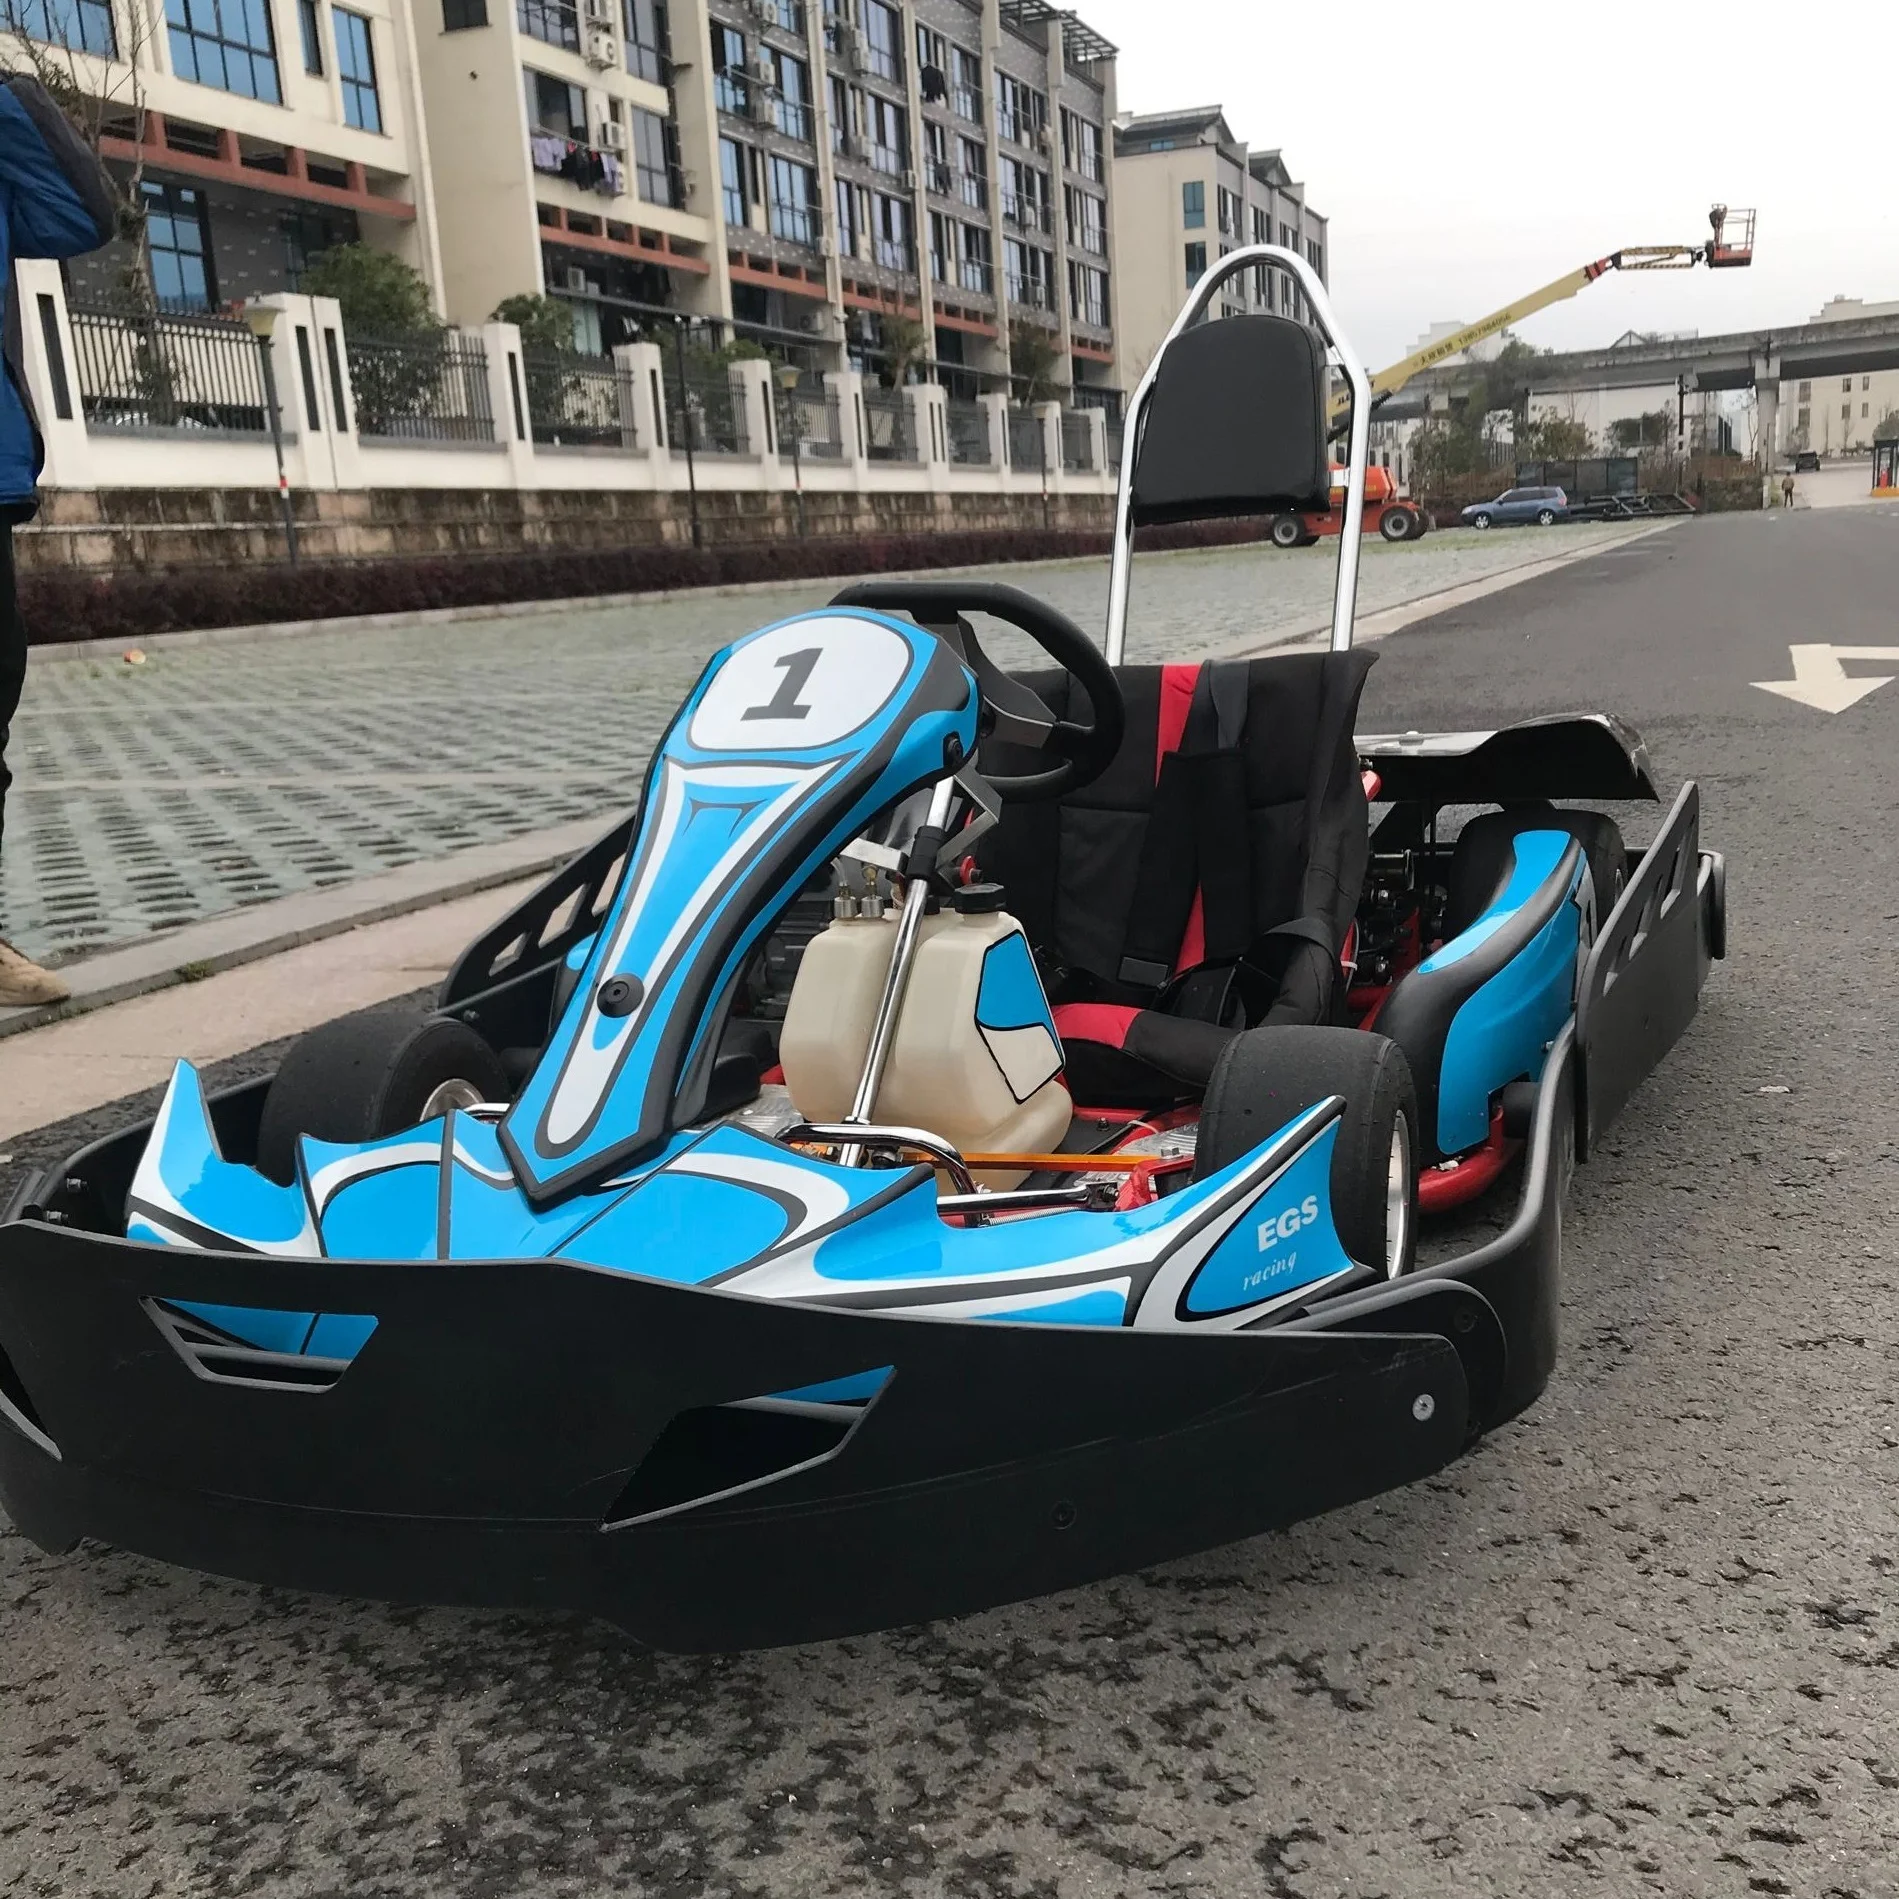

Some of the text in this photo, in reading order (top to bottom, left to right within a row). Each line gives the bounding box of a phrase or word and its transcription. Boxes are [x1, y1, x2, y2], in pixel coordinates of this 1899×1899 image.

[740, 647, 823, 721] 1
[1258, 1195, 1318, 1252] EGS
[1243, 1251, 1296, 1291] racing
